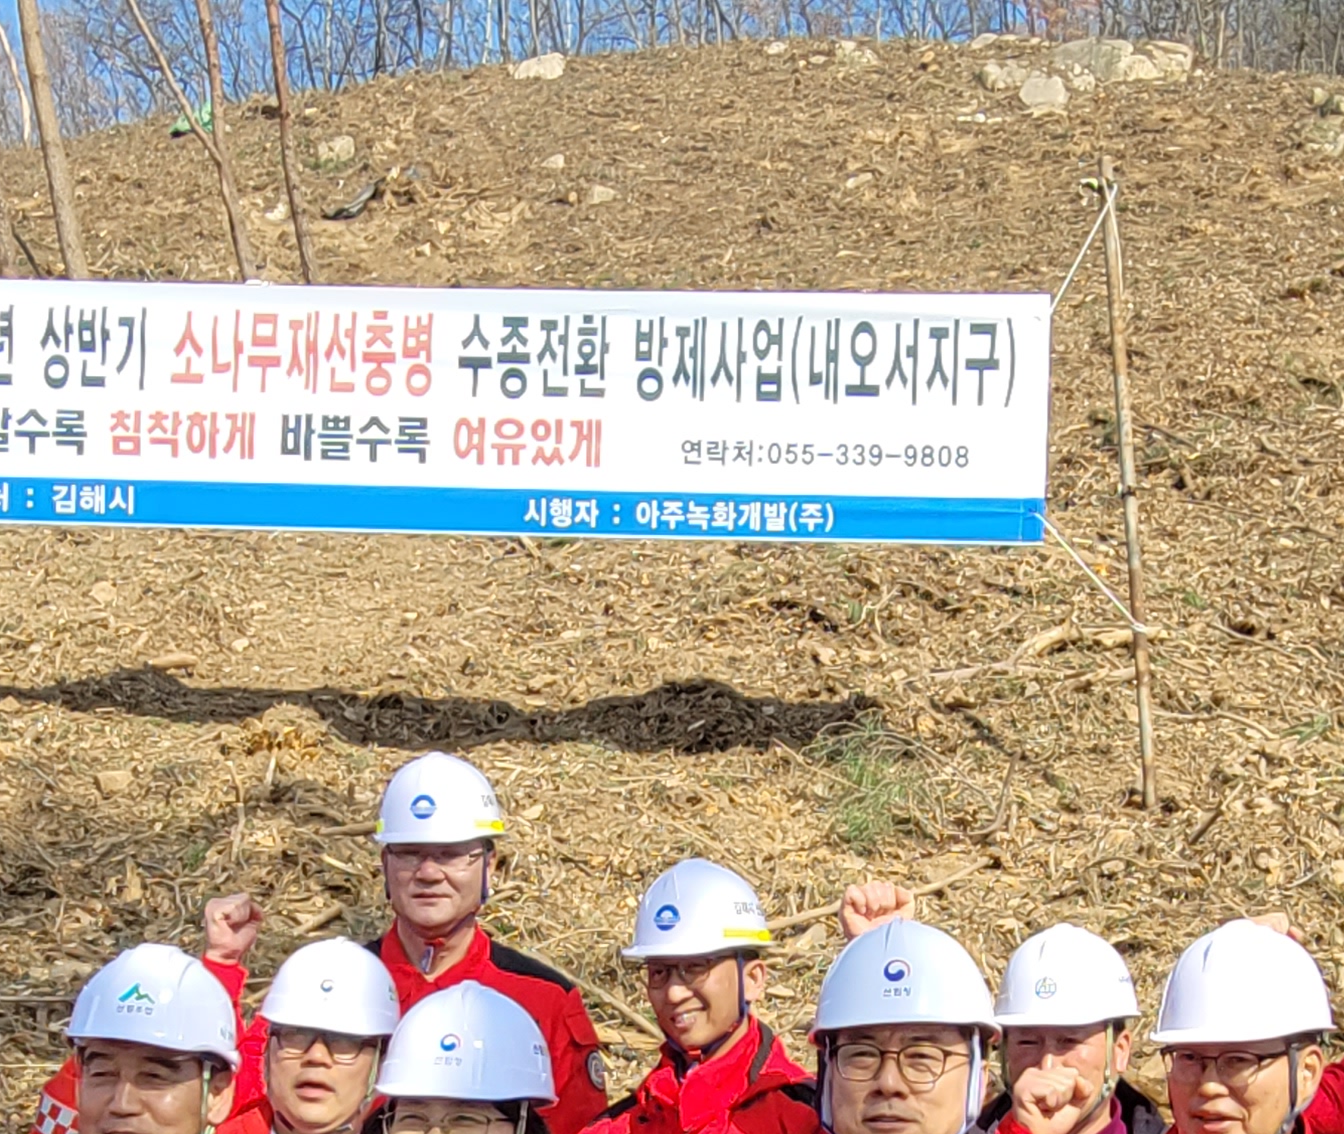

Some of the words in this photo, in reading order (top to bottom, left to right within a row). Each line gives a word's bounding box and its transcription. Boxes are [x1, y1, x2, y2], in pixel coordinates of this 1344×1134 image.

[40, 305, 147, 391] 상반기
[170, 310, 433, 397] 소나무재선충병
[458, 313, 610, 399] 수종전환
[635, 315, 1016, 407] 방제사업(내오서지구)
[110, 410, 255, 460] 침착하게
[280, 413, 431, 464] 바쁠수록
[453, 417, 602, 467] 여유있게
[680, 439, 970, 469] 연락처:055-339-9808
[51, 483, 136, 516] 김해시
[524, 497, 599, 528] 시행자
[635, 501, 835, 533] 아주녹화개발(주)
